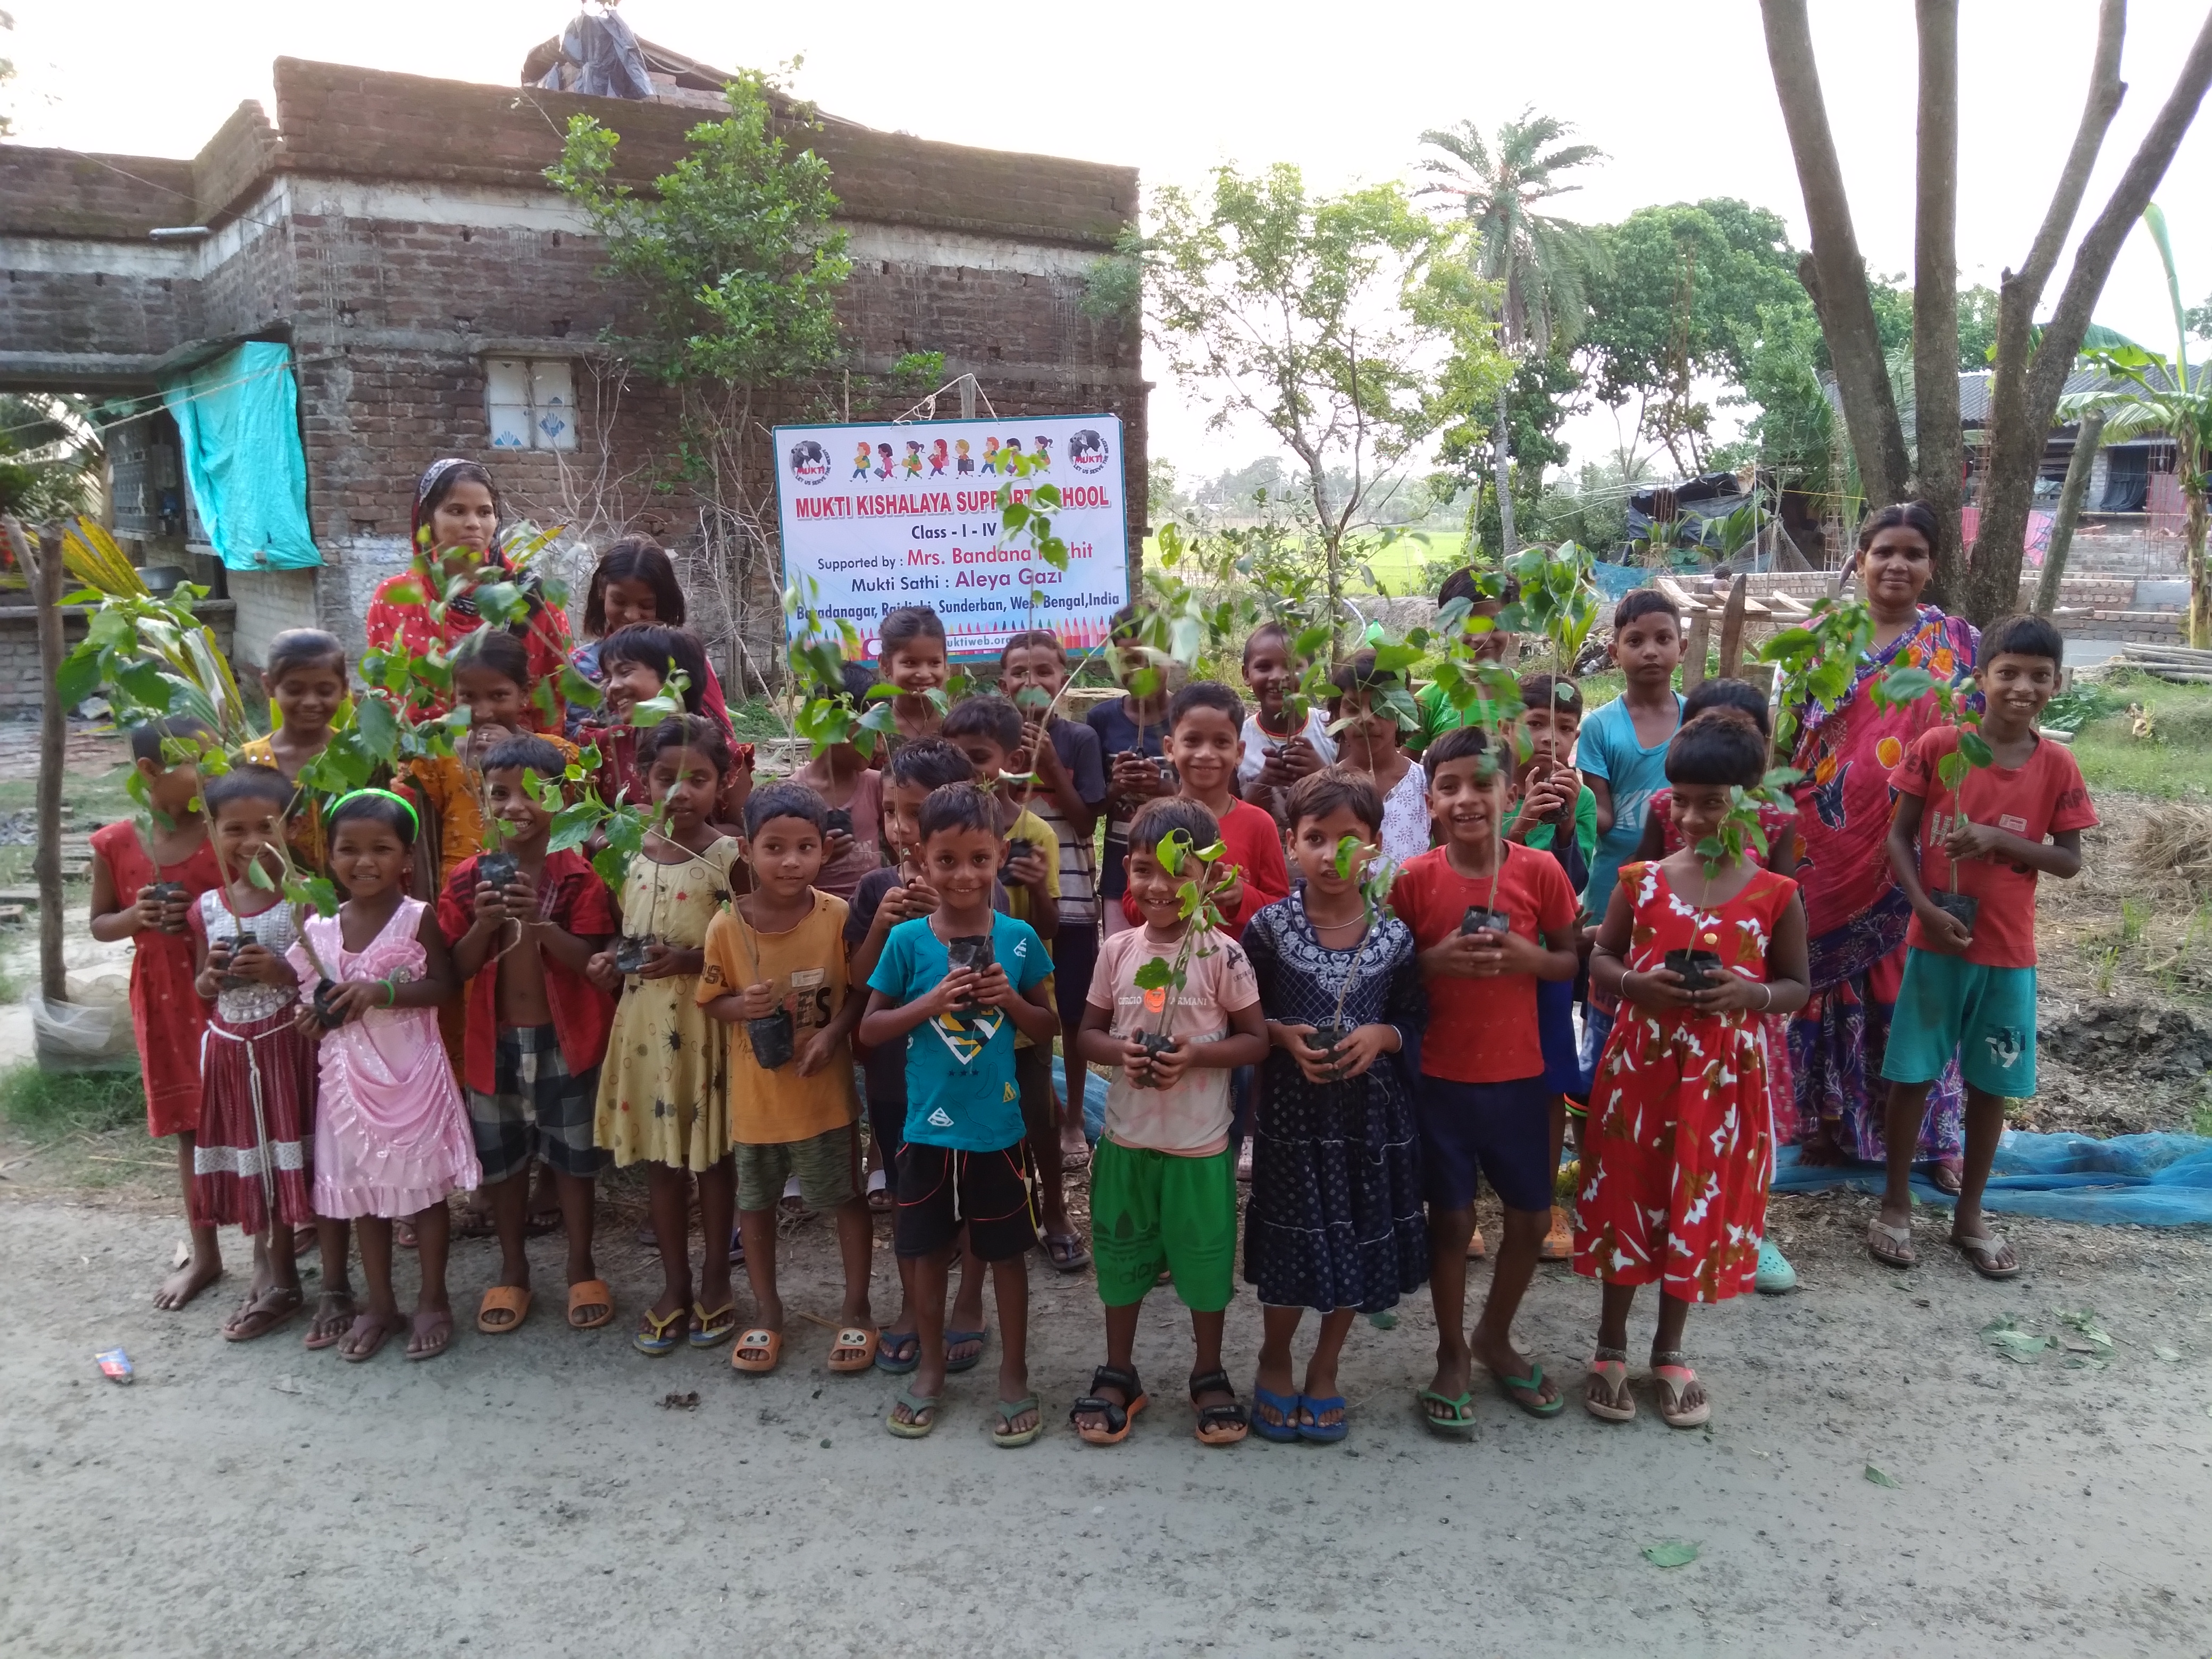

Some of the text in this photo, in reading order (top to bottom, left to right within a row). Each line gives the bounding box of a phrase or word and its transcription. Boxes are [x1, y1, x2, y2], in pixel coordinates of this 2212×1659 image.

[1075, 454, 1103, 464] MUKTI
[797, 465, 825, 475] MUKTI
[1073, 463, 1082, 472] LET
[1090, 464, 1104, 474] SERVE
[811, 474, 827, 486] SERVE
[796, 496, 851, 518] MUKTI
[857, 492, 952, 515] KISHALAYA
[957, 489, 1035, 512] SUPPRT
[911, 524, 947, 539] Class
[962, 523, 966, 537] I
[983, 522, 997, 537] IV
[818, 556, 878, 572] Supported
[882, 556, 896, 569] by
[908, 549, 945, 566] Mrs.
[952, 545, 1032, 564] Bandana
[852, 577, 895, 592] Mukti
[901, 575, 939, 590] Sathi
[955, 569, 1011, 591] Aleya
[1018, 568, 1062, 585] Gazi
[797, 604, 878, 621] Baadanagar,
[939, 598, 1007, 613] Sunderban,
[1170, 996, 1208, 1006] ARMANI
